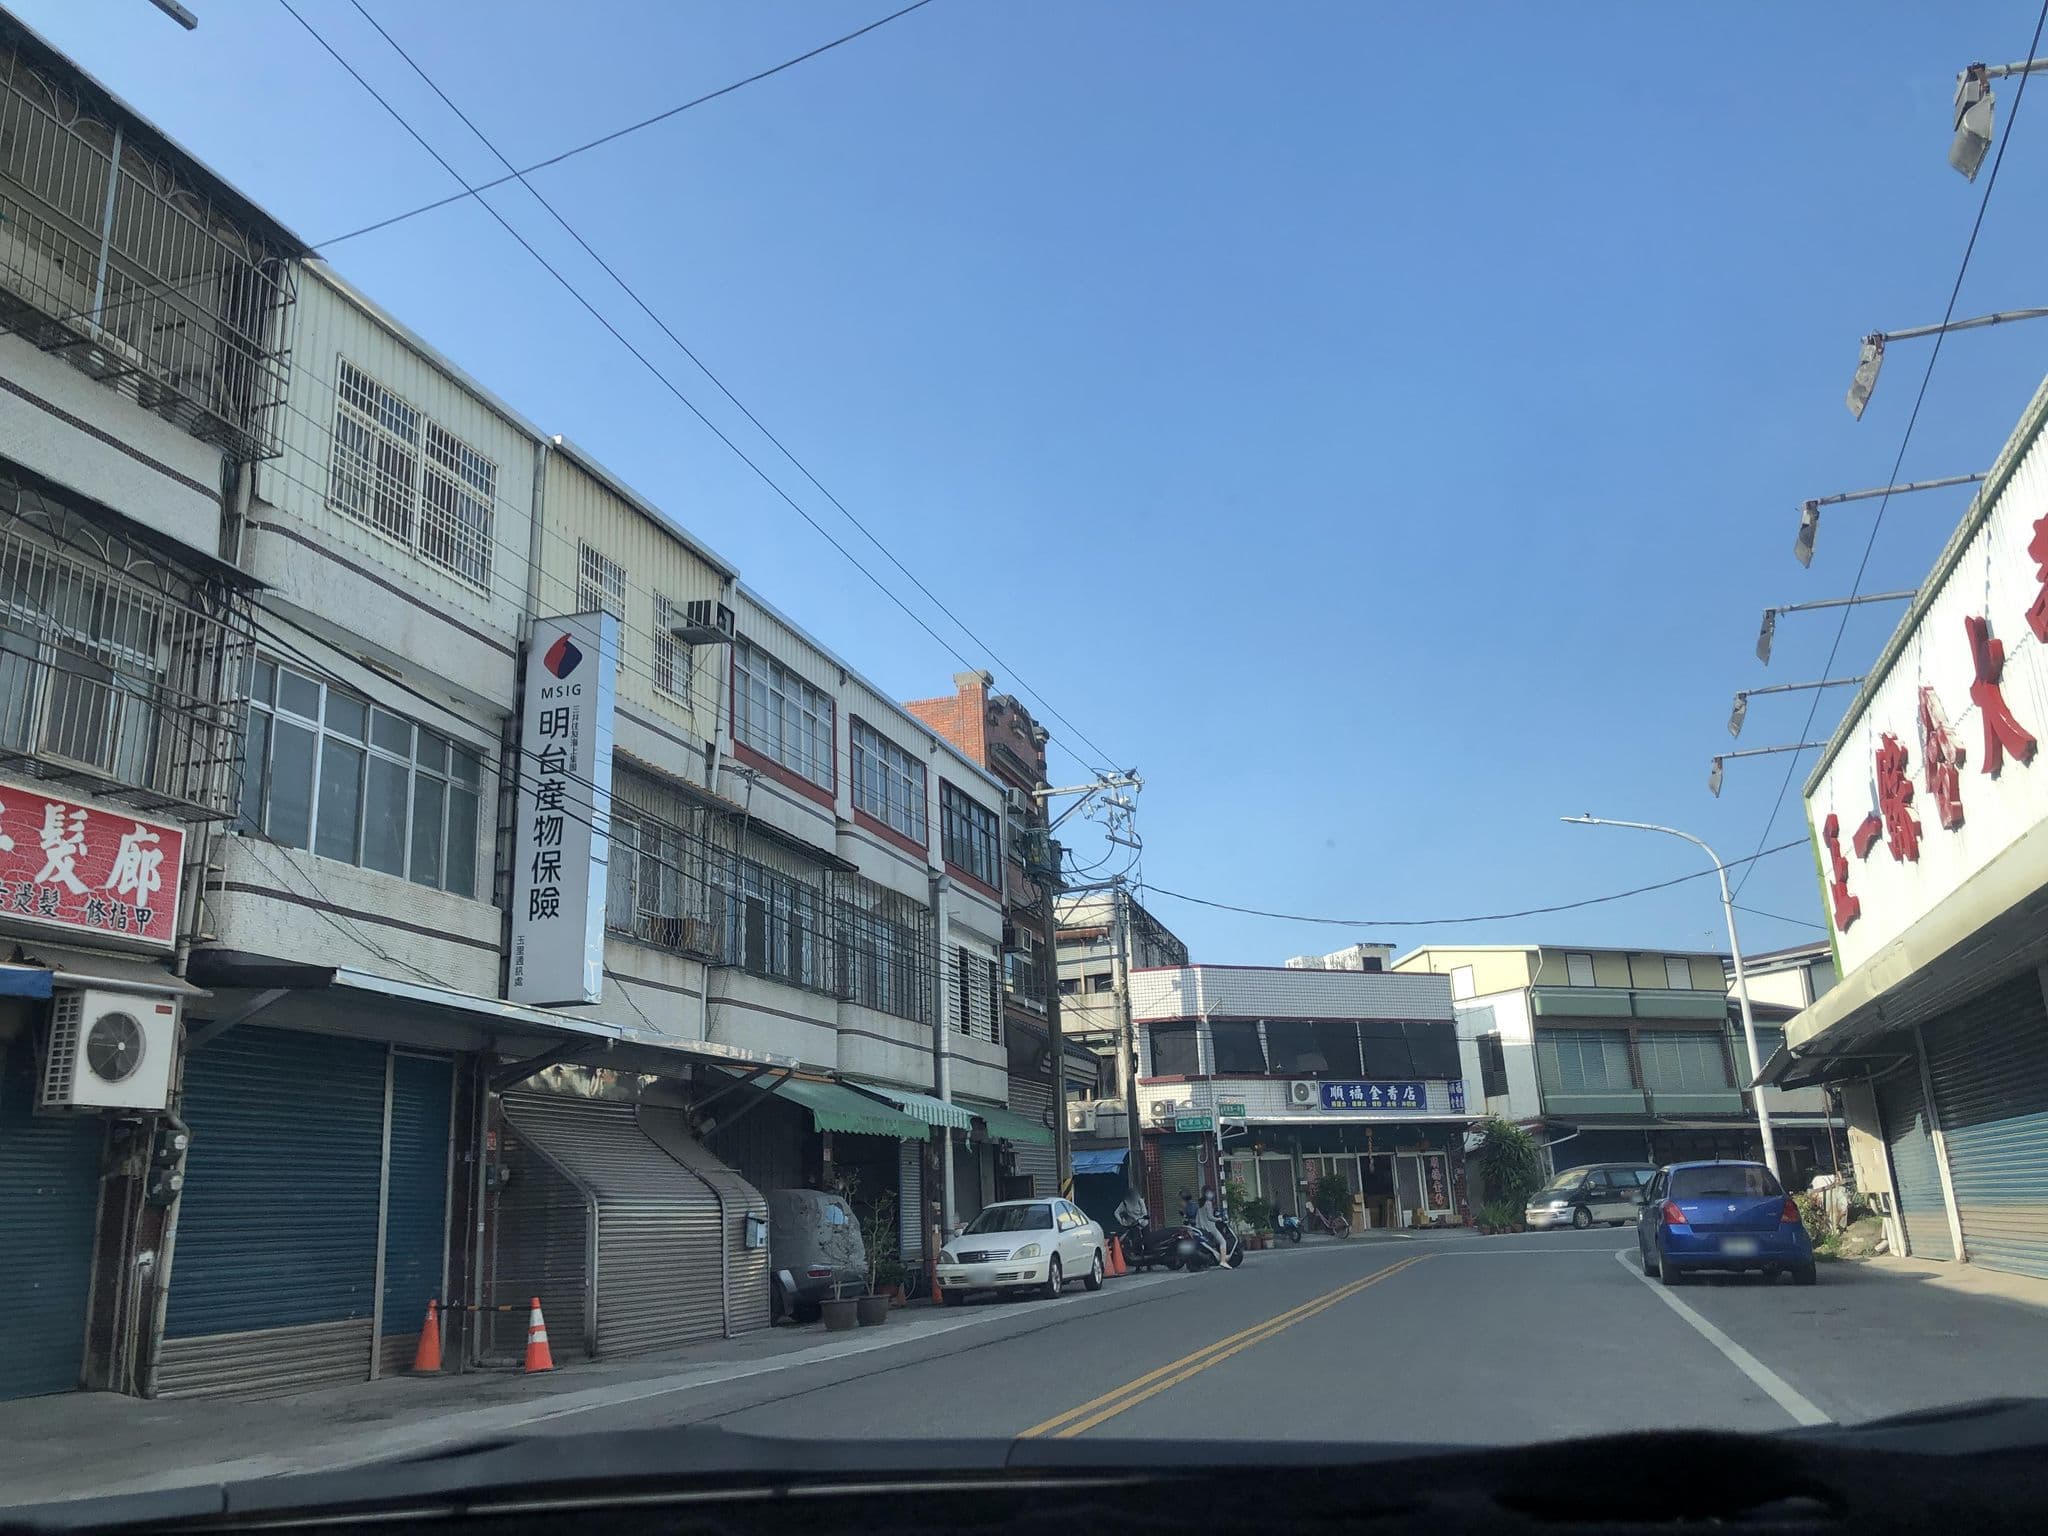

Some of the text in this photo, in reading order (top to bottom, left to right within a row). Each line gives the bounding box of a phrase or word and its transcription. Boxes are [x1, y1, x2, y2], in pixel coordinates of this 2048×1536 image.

[541, 684, 582, 699] MSIG
[0, 799, 164, 907] 髮廊
[87, 898, 153, 933] 修指甲
[1330, 1085, 1417, 1101] 順福金香店
